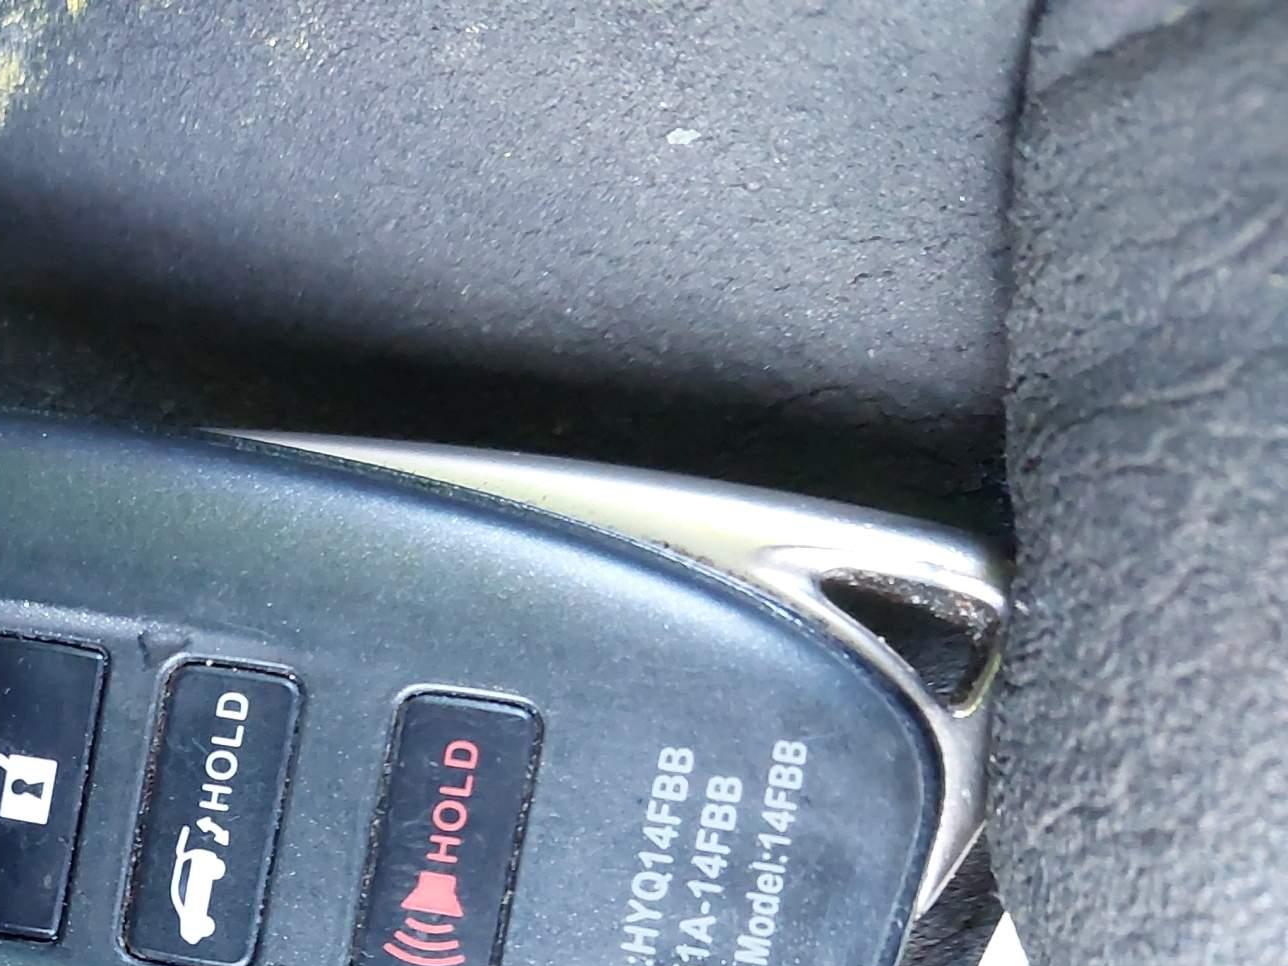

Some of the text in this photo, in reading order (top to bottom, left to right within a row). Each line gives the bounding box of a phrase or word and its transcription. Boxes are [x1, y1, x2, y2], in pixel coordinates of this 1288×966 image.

[199, 691, 249, 812] HOLD
[427, 740, 479, 864] HOLD
[734, 740, 808, 966] Model:14FBB
